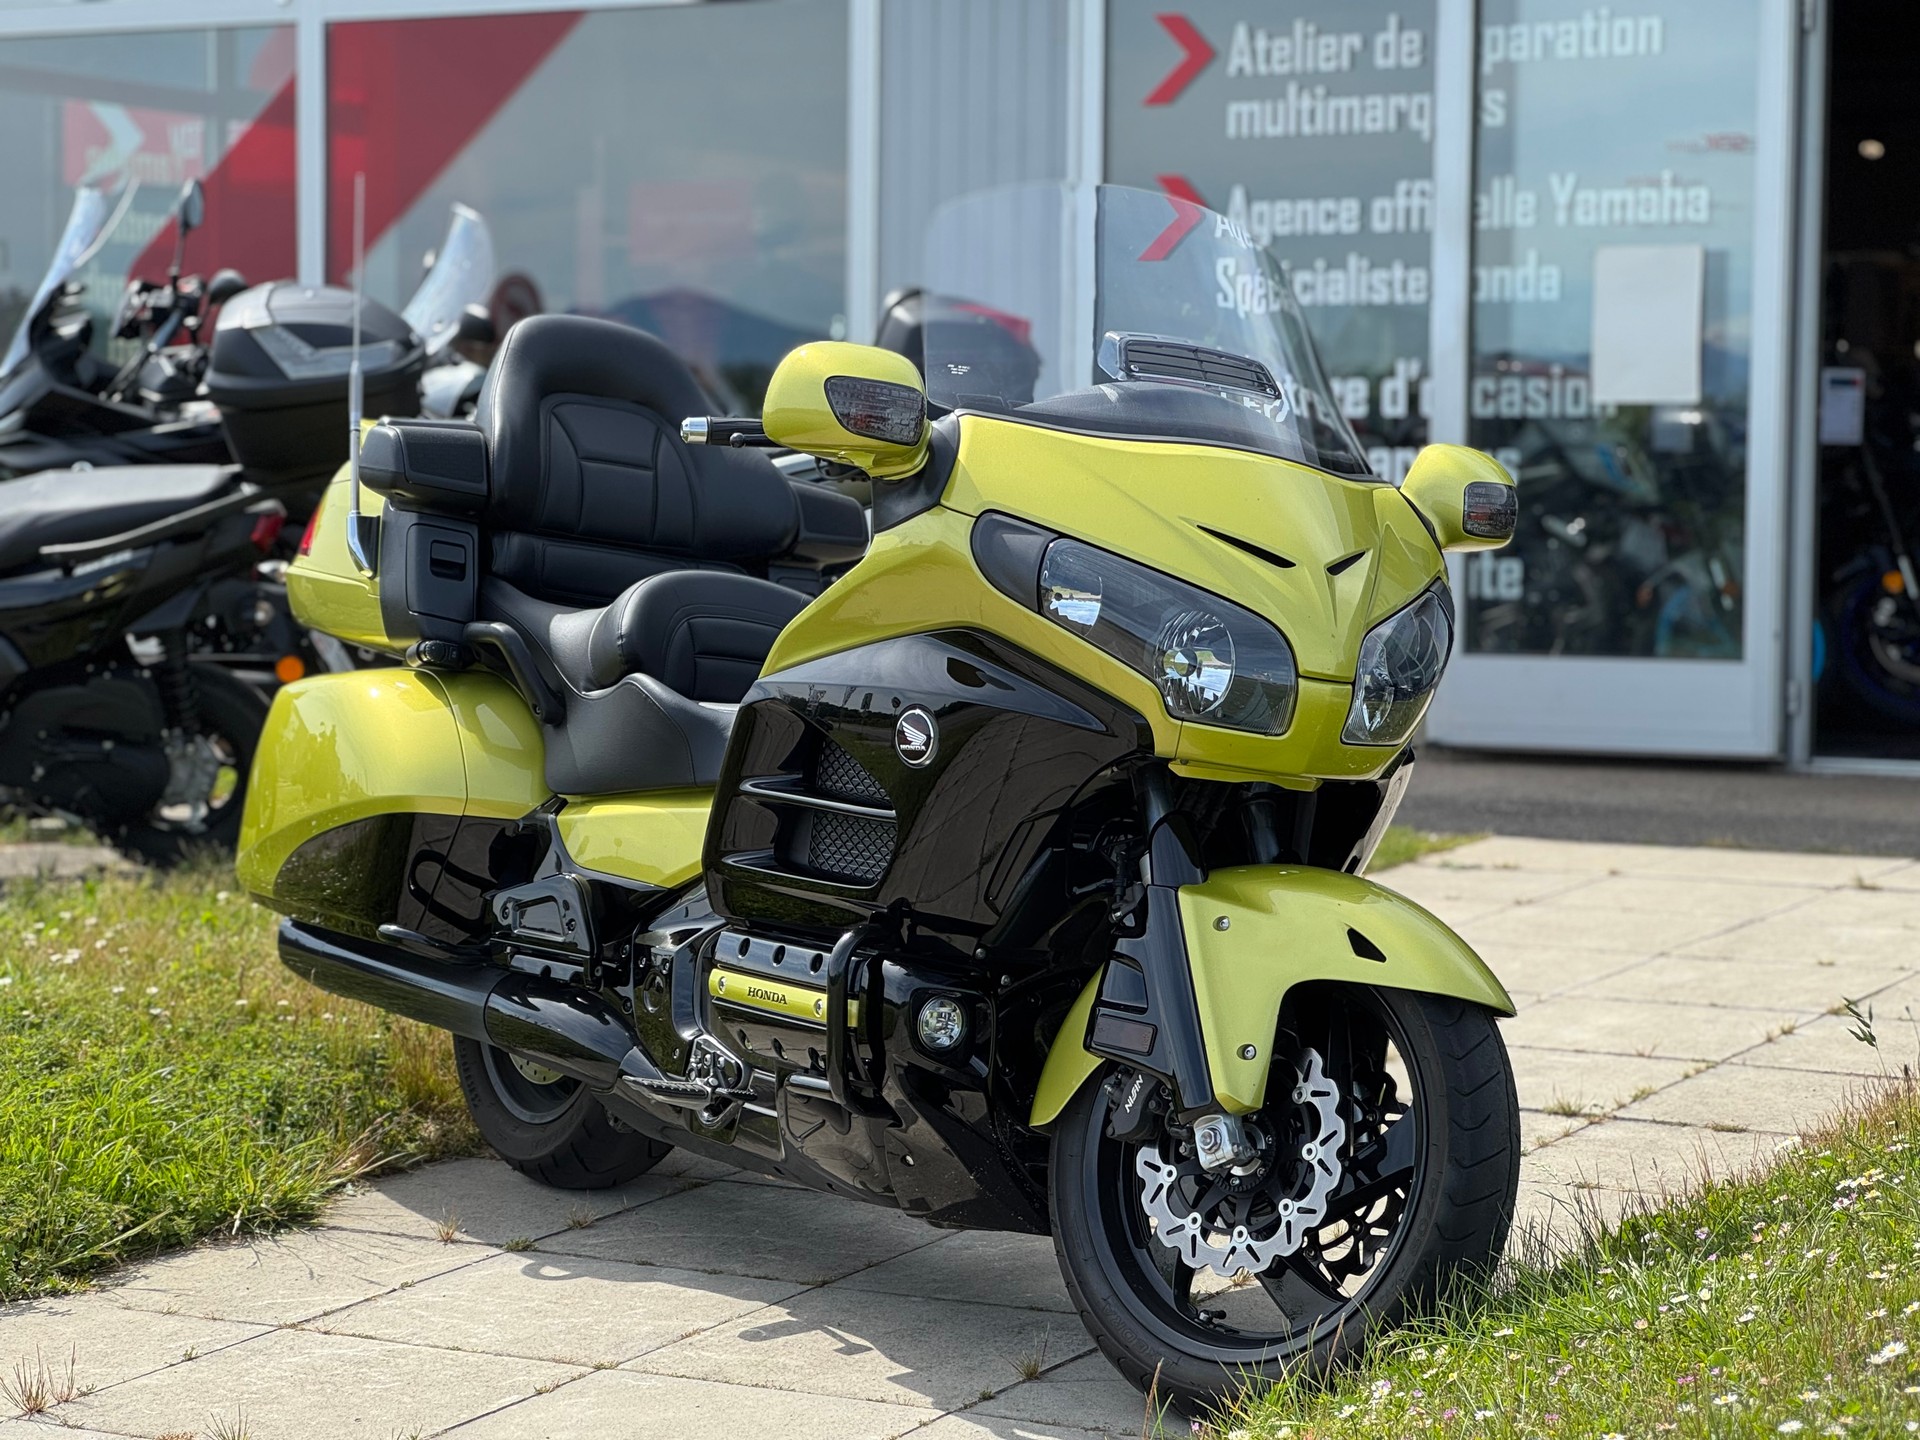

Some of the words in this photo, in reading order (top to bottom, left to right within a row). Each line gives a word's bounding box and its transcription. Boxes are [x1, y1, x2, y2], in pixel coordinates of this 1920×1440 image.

[1227, 18, 1362, 76] Atelier
[1374, 13, 1424, 69] de
[1483, 7, 1662, 74] paration
[1226, 81, 1506, 141] multimarqs
[1549, 170, 1710, 226] Yamaha
[1475, 249, 1562, 302] onda
[747, 986, 788, 1005] HONDA
